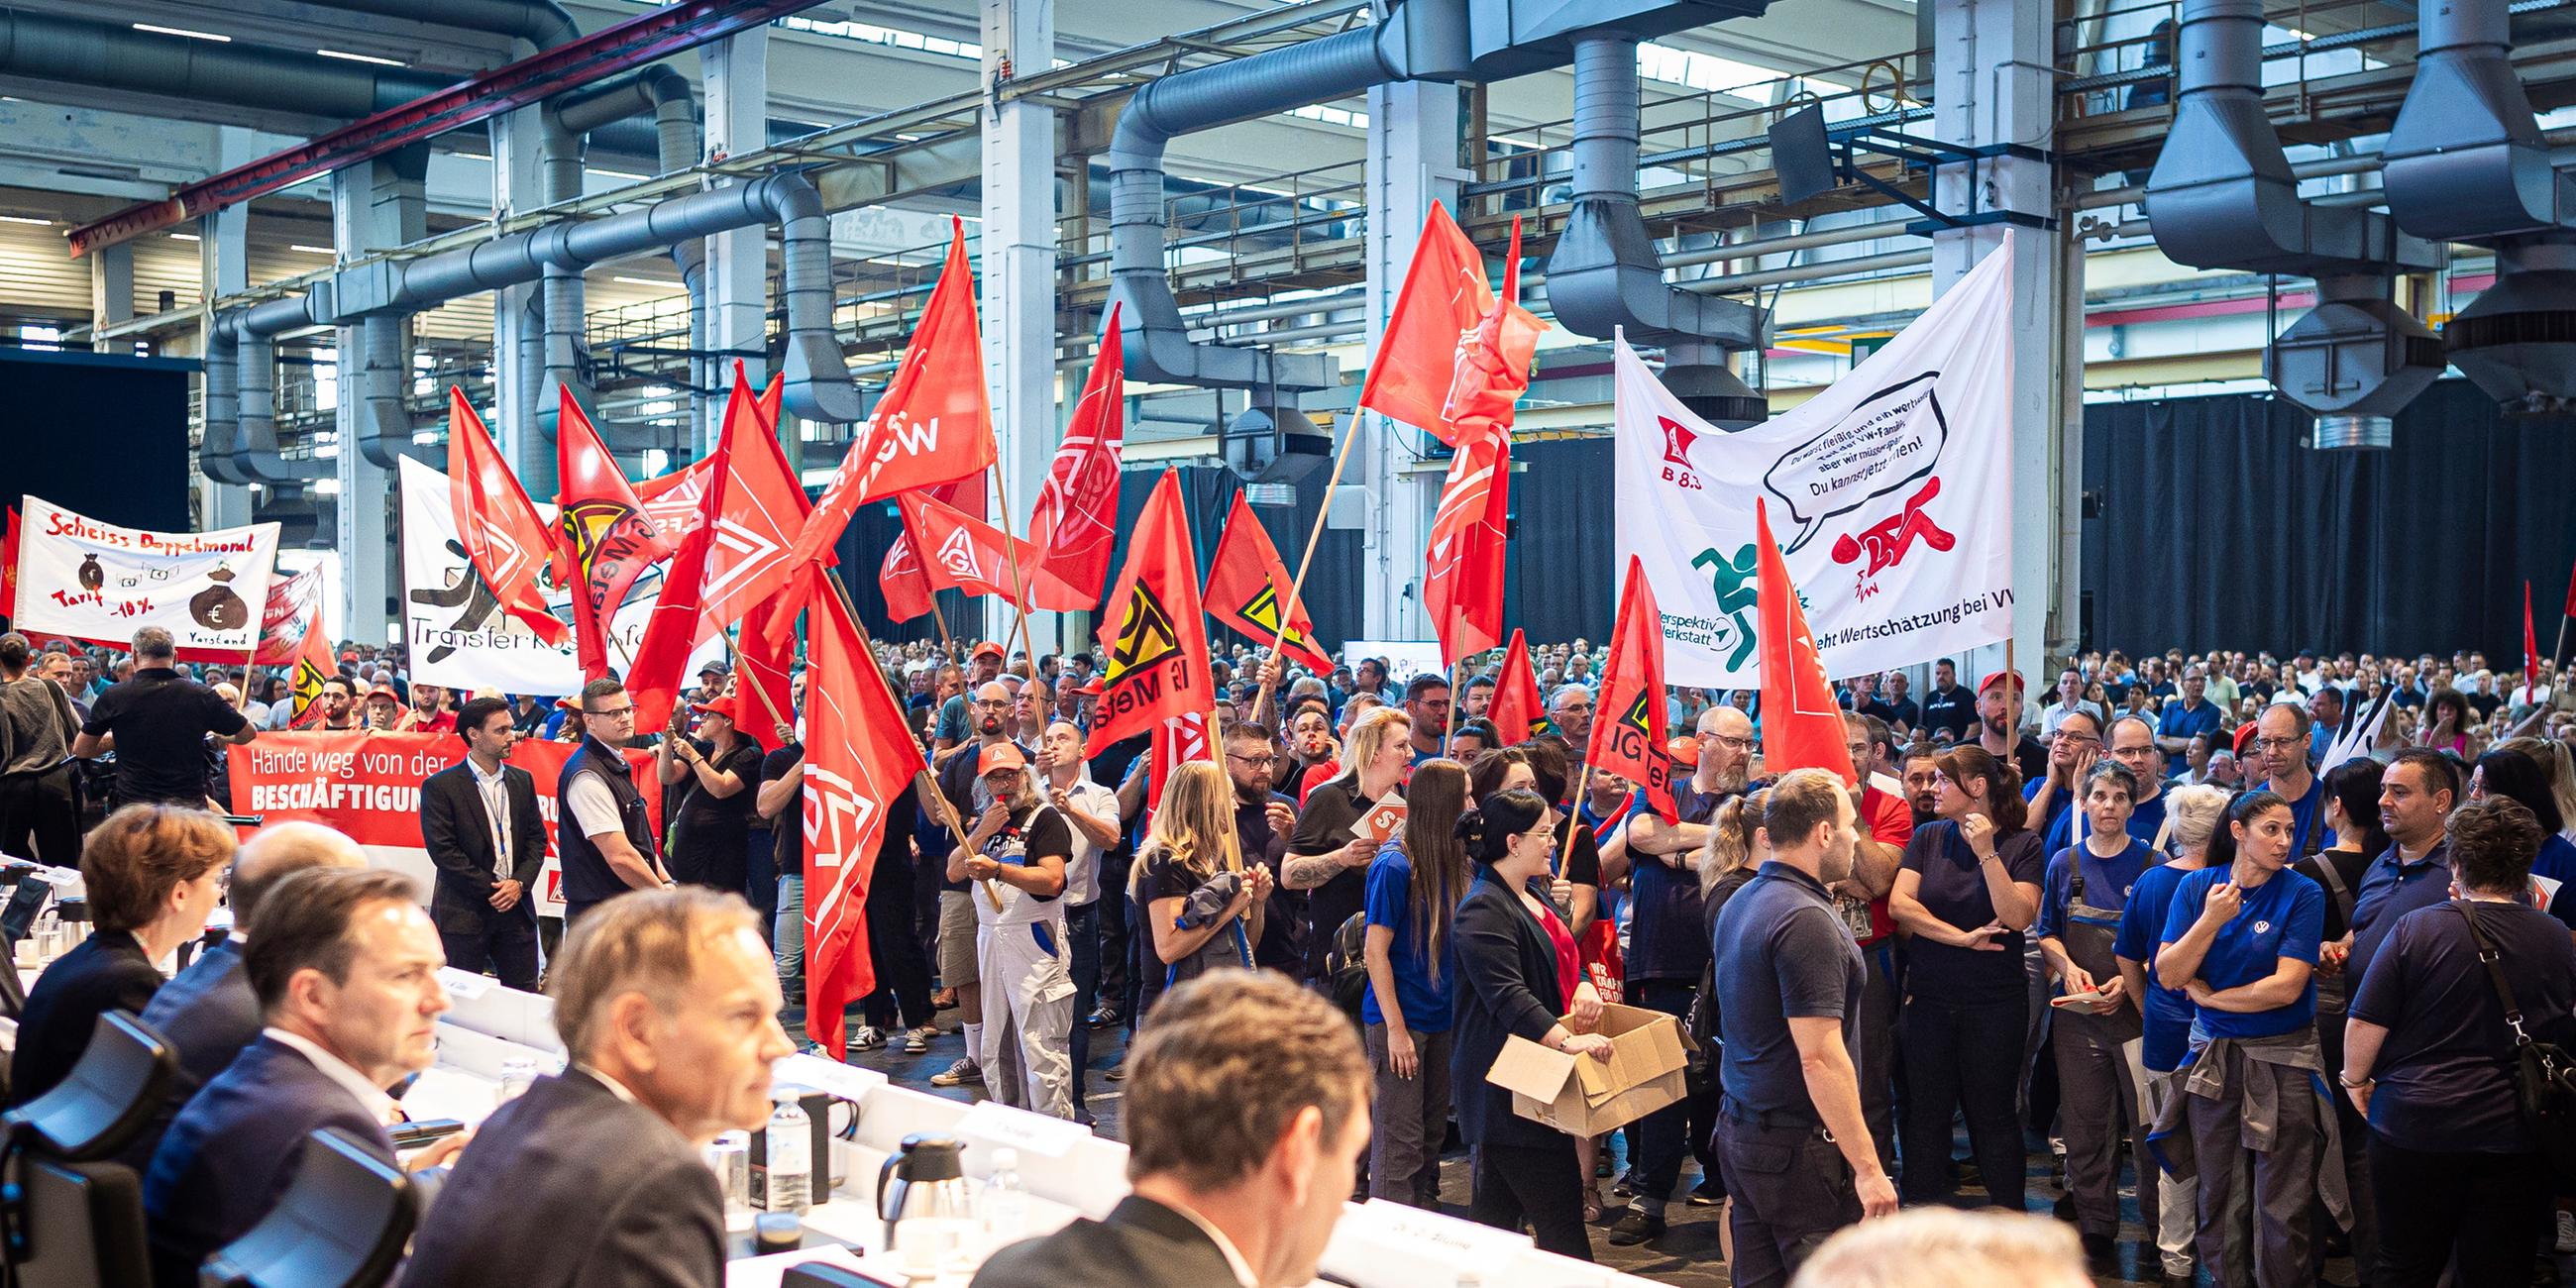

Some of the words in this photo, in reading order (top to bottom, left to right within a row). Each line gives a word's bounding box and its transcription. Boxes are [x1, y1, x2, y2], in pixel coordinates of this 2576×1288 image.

[1854, 420, 1874, 434] und
[1876, 411, 1892, 422] ein
[1818, 460, 1841, 473] aber
[1843, 453, 1858, 465] wir
[1662, 466, 1674, 482] B
[1678, 472, 1702, 490] 8.3
[1810, 482, 1829, 496] Du
[46, 512, 130, 547] Scheiss
[51, 585, 103, 608] Tarif
[1659, 610, 1717, 630] erspektiv
[1816, 633, 1837, 650] eht
[1840, 605, 1960, 644] Wertschätzung
[1963, 592, 1987, 616] bei
[1662, 625, 1712, 645] erkstatt
[1610, 725, 1643, 762] IG
[251, 747, 306, 775] Hände
[312, 751, 355, 779] weg
[363, 752, 403, 776] von
[411, 749, 449, 776] der
[252, 777, 421, 812] BESCHÄFTIGUN
